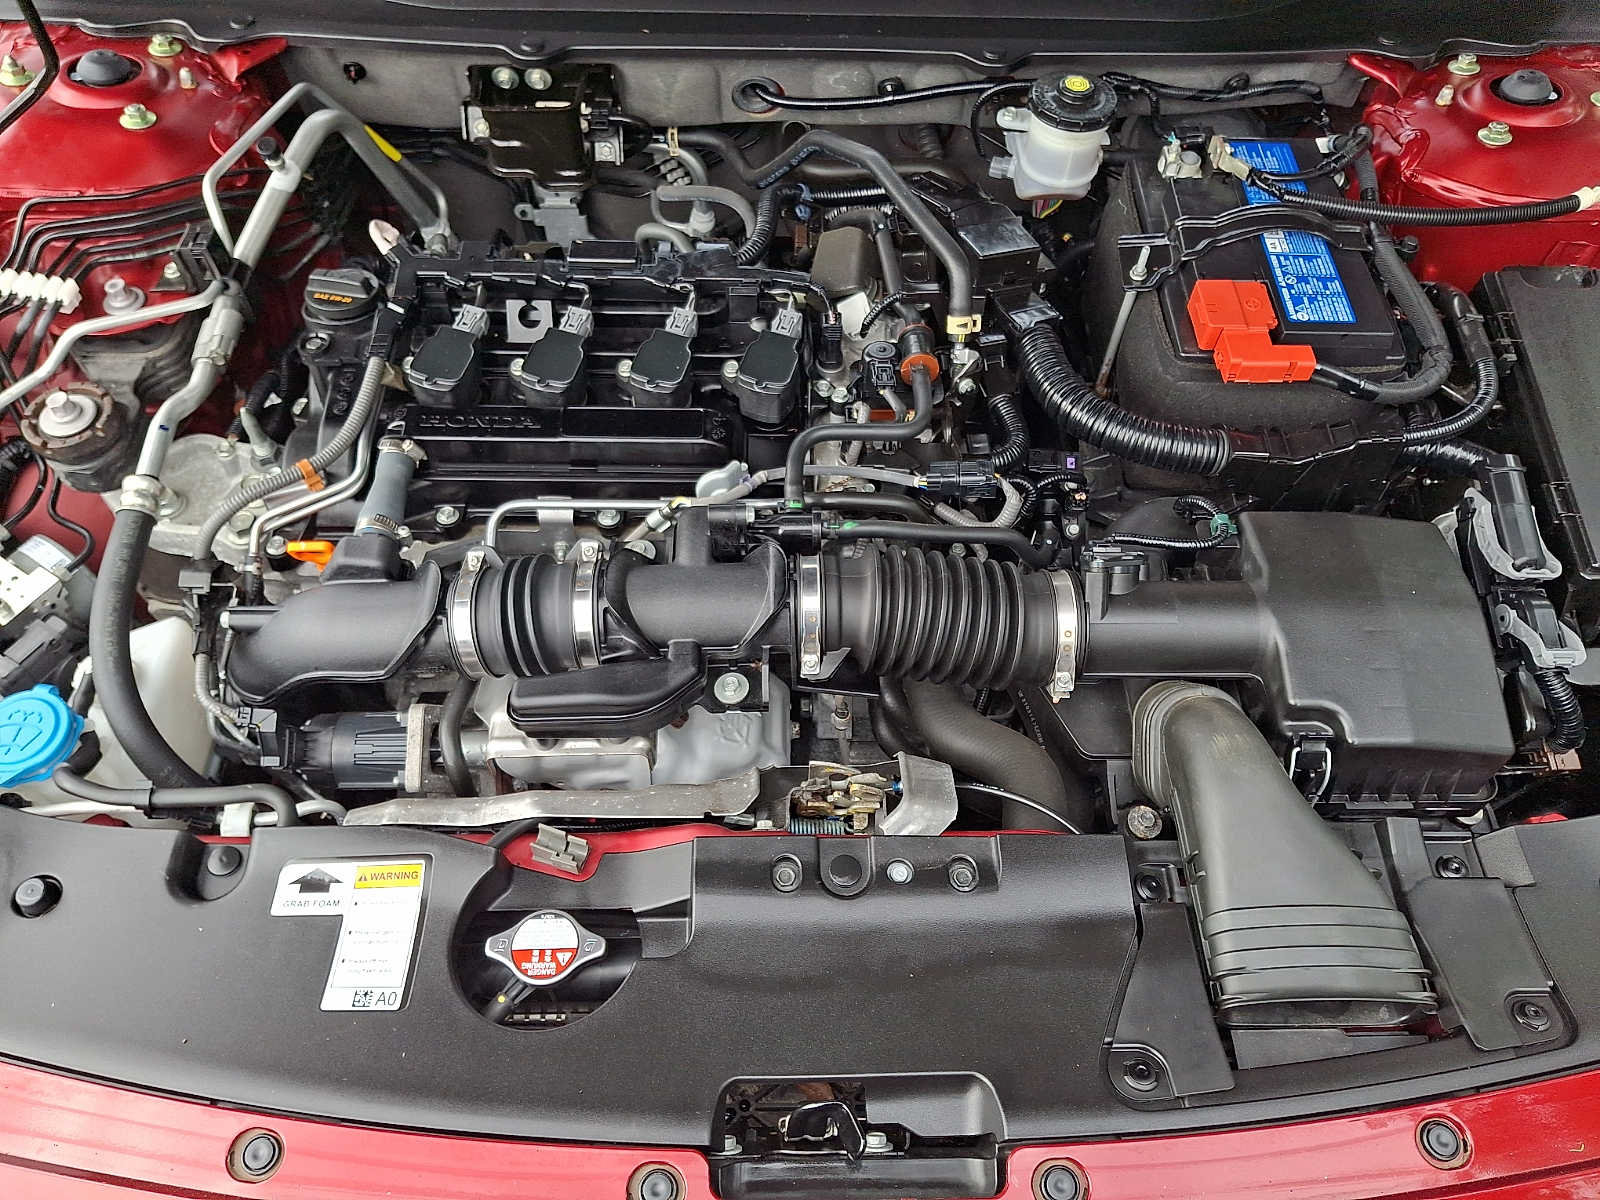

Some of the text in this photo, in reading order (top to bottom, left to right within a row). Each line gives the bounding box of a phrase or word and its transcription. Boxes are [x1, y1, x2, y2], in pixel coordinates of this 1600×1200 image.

[419, 415, 542, 429] HONDA
[370, 871, 420, 882] WARNING
[282, 899, 341, 908] GRAB FOAM
